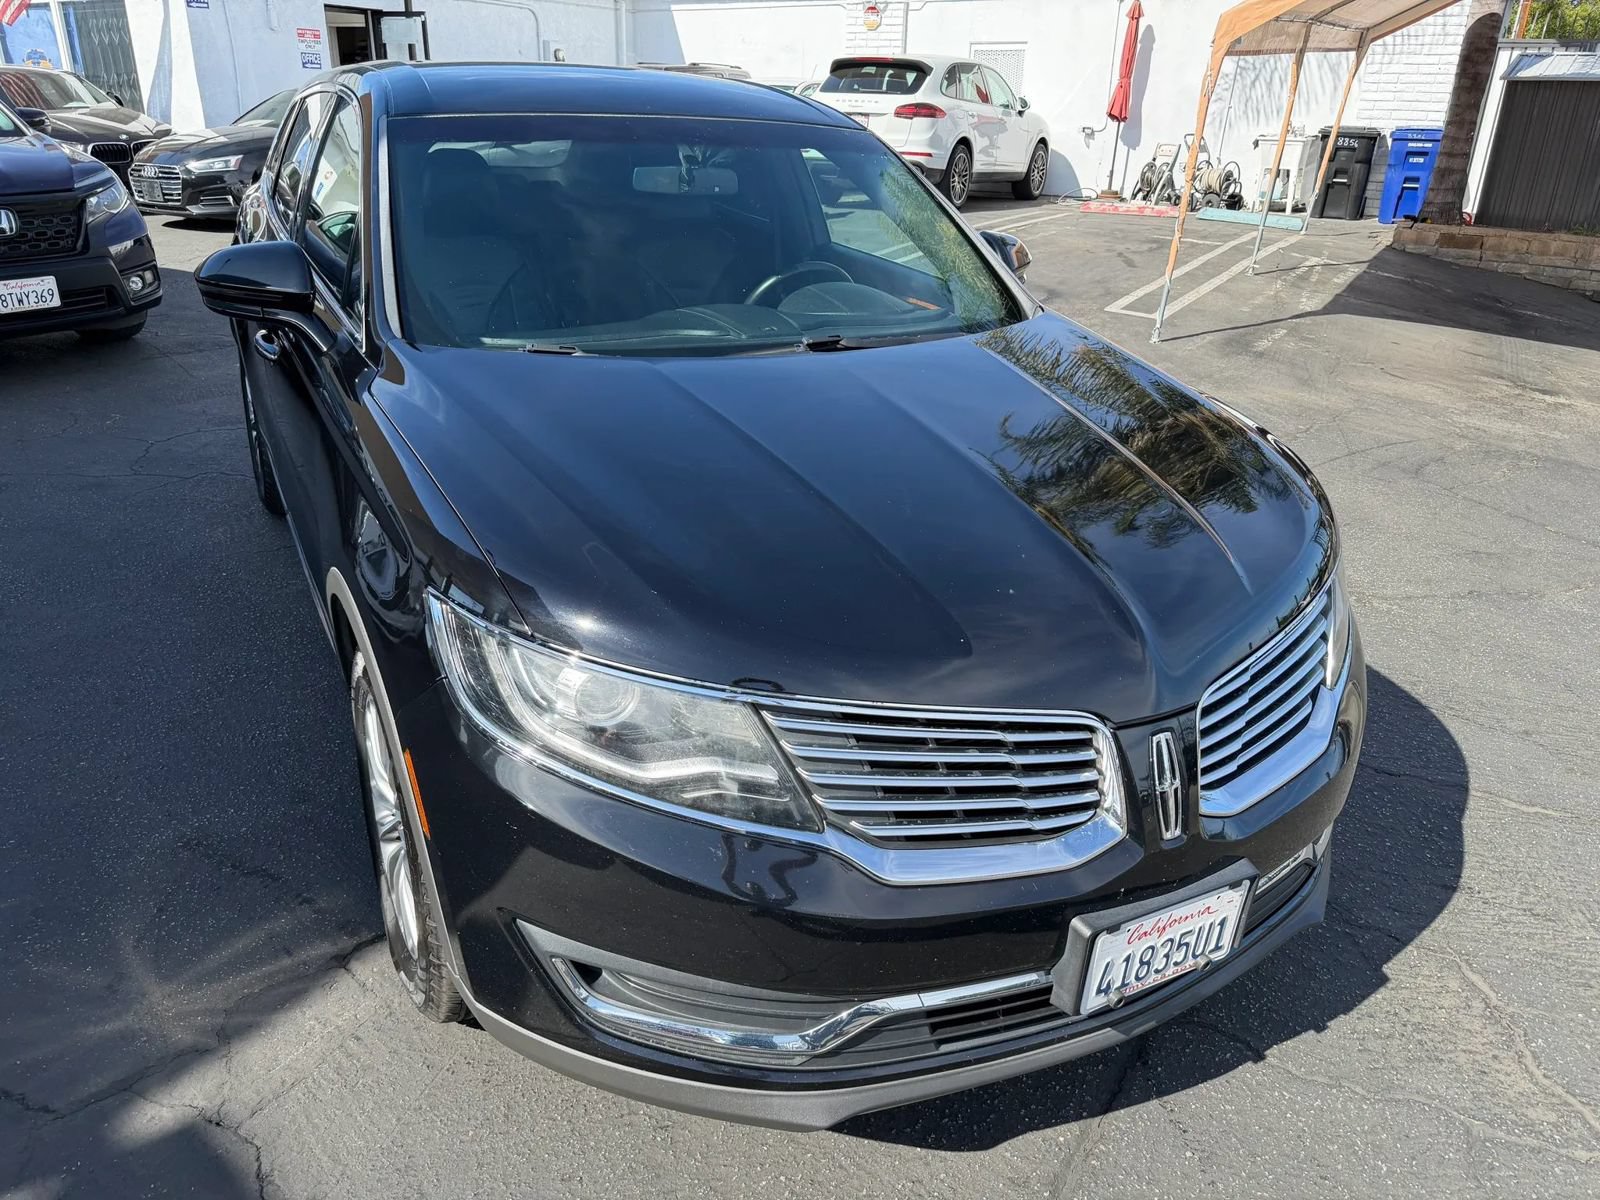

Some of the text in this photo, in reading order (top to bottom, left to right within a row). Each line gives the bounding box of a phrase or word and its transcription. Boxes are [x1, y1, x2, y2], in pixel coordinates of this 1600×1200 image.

[302, 54, 320, 63] OFFICE
[5, 281, 45, 290] California
[0, 288, 54, 308] 8TWY369
[1127, 904, 1218, 945] California
[1095, 916, 1227, 996] 41835U1
